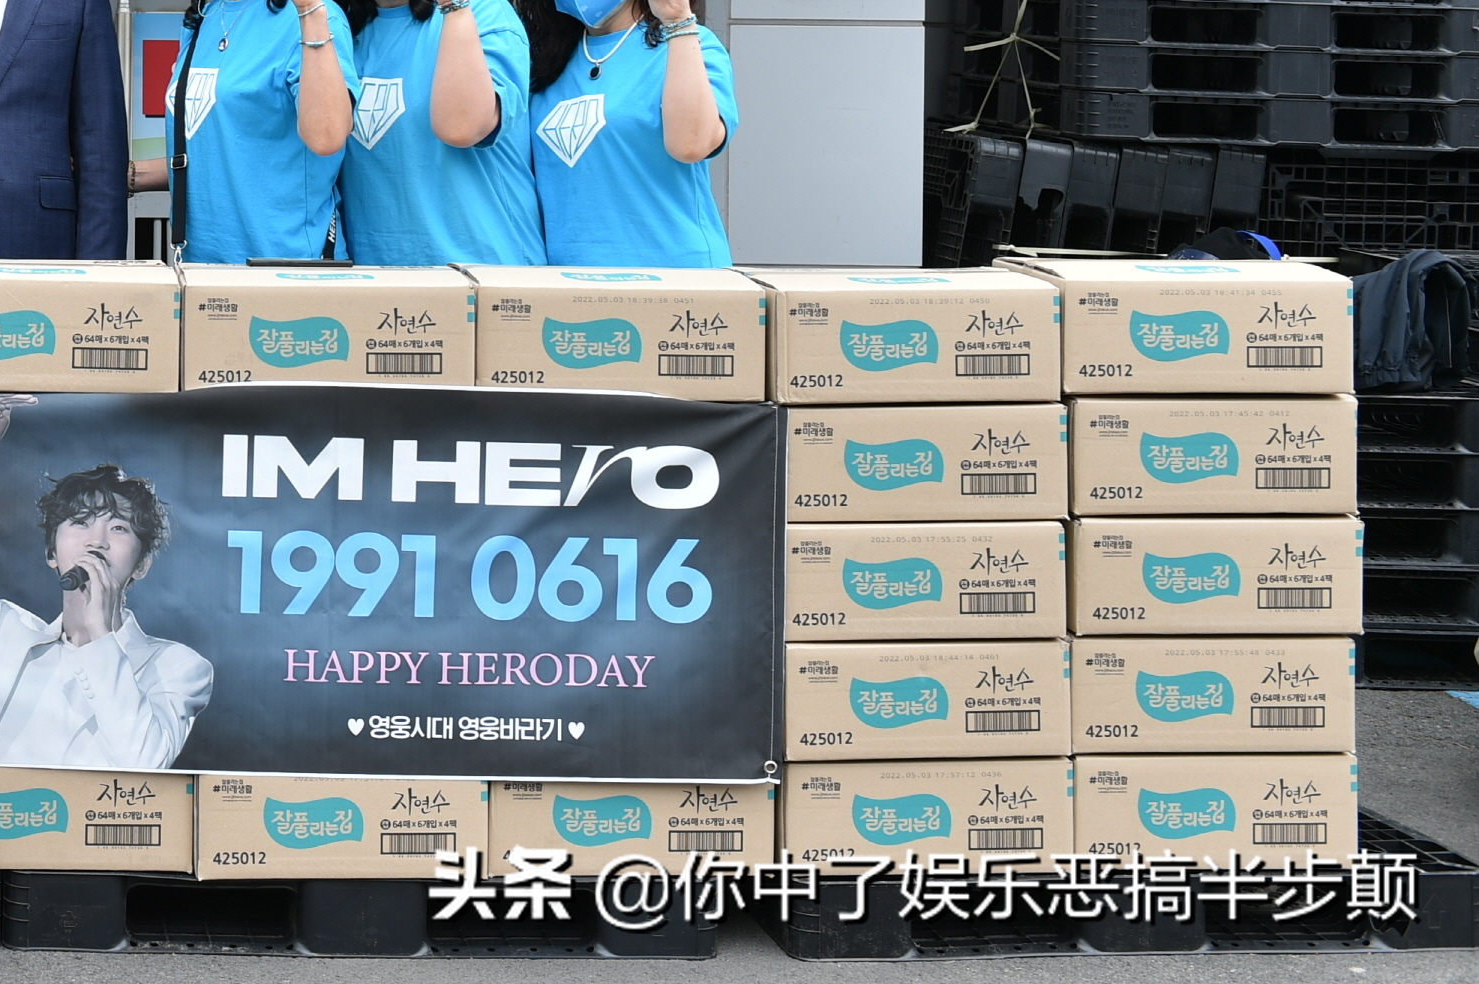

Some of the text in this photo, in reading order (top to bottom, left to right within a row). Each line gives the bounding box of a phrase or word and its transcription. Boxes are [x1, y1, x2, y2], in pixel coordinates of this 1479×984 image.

[670, 311, 730, 338] 자연수
[966, 311, 1024, 337] 자연수
[1258, 302, 1318, 329] 자연수
[255, 328, 340, 358] 잘풀리는집
[548, 329, 633, 359] 잘풀리는집
[847, 332, 930, 361] 잘풀리는집
[790, 373, 845, 389] 425012
[1079, 363, 1134, 379] 425012
[222, 434, 365, 501] IM
[227, 529, 712, 624] 1991 0616
[849, 569, 934, 599] 잘풀리는집
[1149, 564, 1232, 593] 잘풀리는집
[793, 612, 846, 628] 425012
[1093, 606, 1146, 622] 425012
[283, 648, 656, 688] HAPPY HERODAY
[976, 666, 1036, 693] 자연수
[1262, 663, 1320, 689] 자연수
[1141, 682, 1226, 712] 잘풀리는집
[368, 714, 563, 741] 영웅시대 영웅바라기
[97, 780, 157, 807] 자연수
[859, 806, 942, 835] 잘풀리는집
[213, 851, 268, 867] 425012
